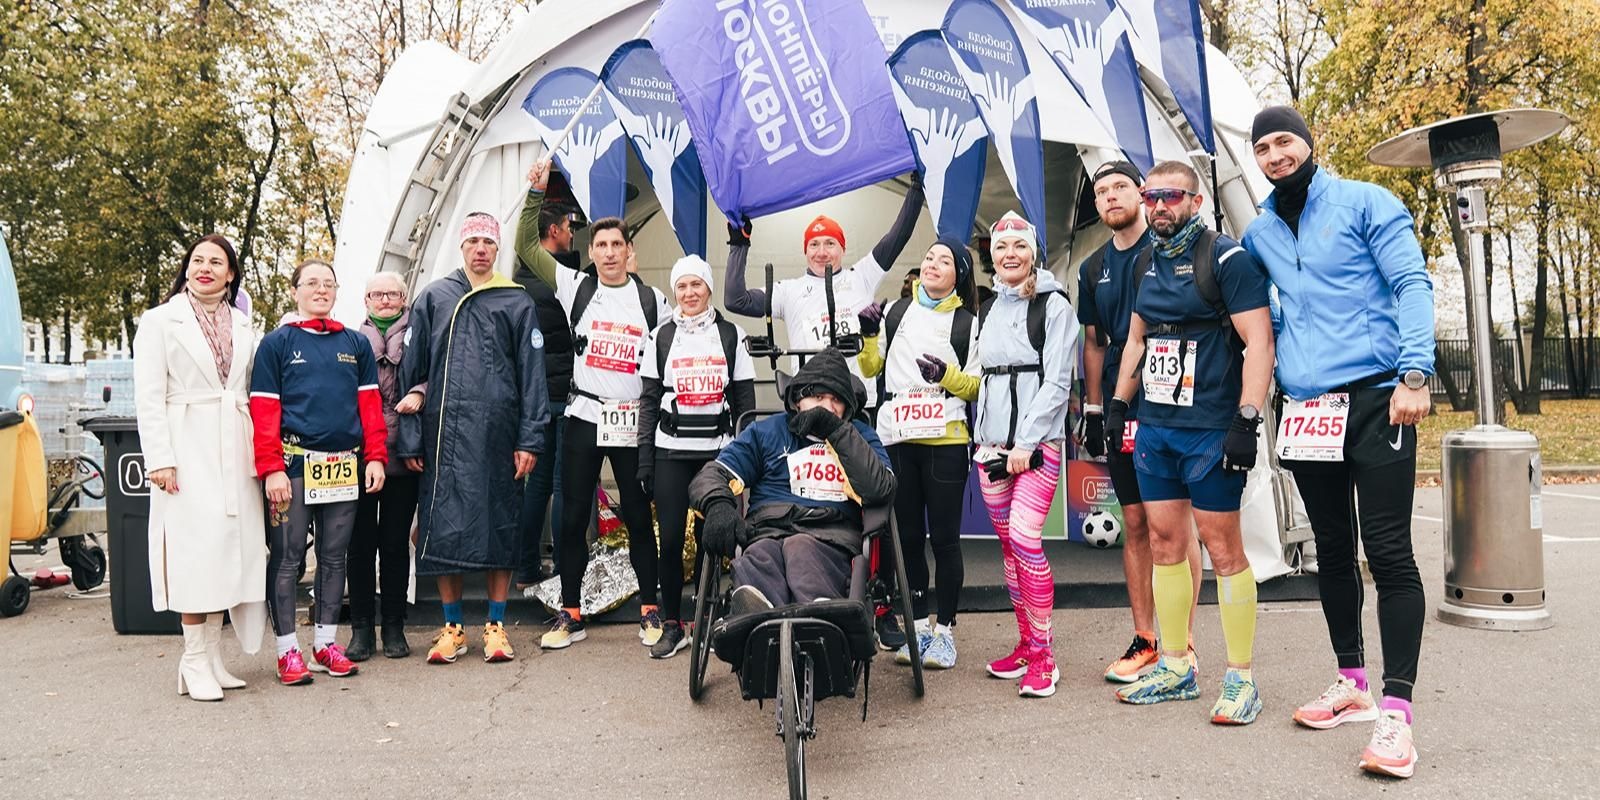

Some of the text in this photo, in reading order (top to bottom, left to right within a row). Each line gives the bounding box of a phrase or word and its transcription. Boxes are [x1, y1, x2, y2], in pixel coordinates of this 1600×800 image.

[591, 340, 635, 360] БЕГУНА
[1150, 355, 1178, 376] 813
[677, 376, 723, 392] БЕГУНА
[601, 411, 635, 426] 1011
[894, 403, 944, 423] 17502
[1284, 416, 1344, 437] 17455
[1282, 446, 1291, 456] E
[312, 462, 352, 480] 8175
[309, 488, 317, 499] G
